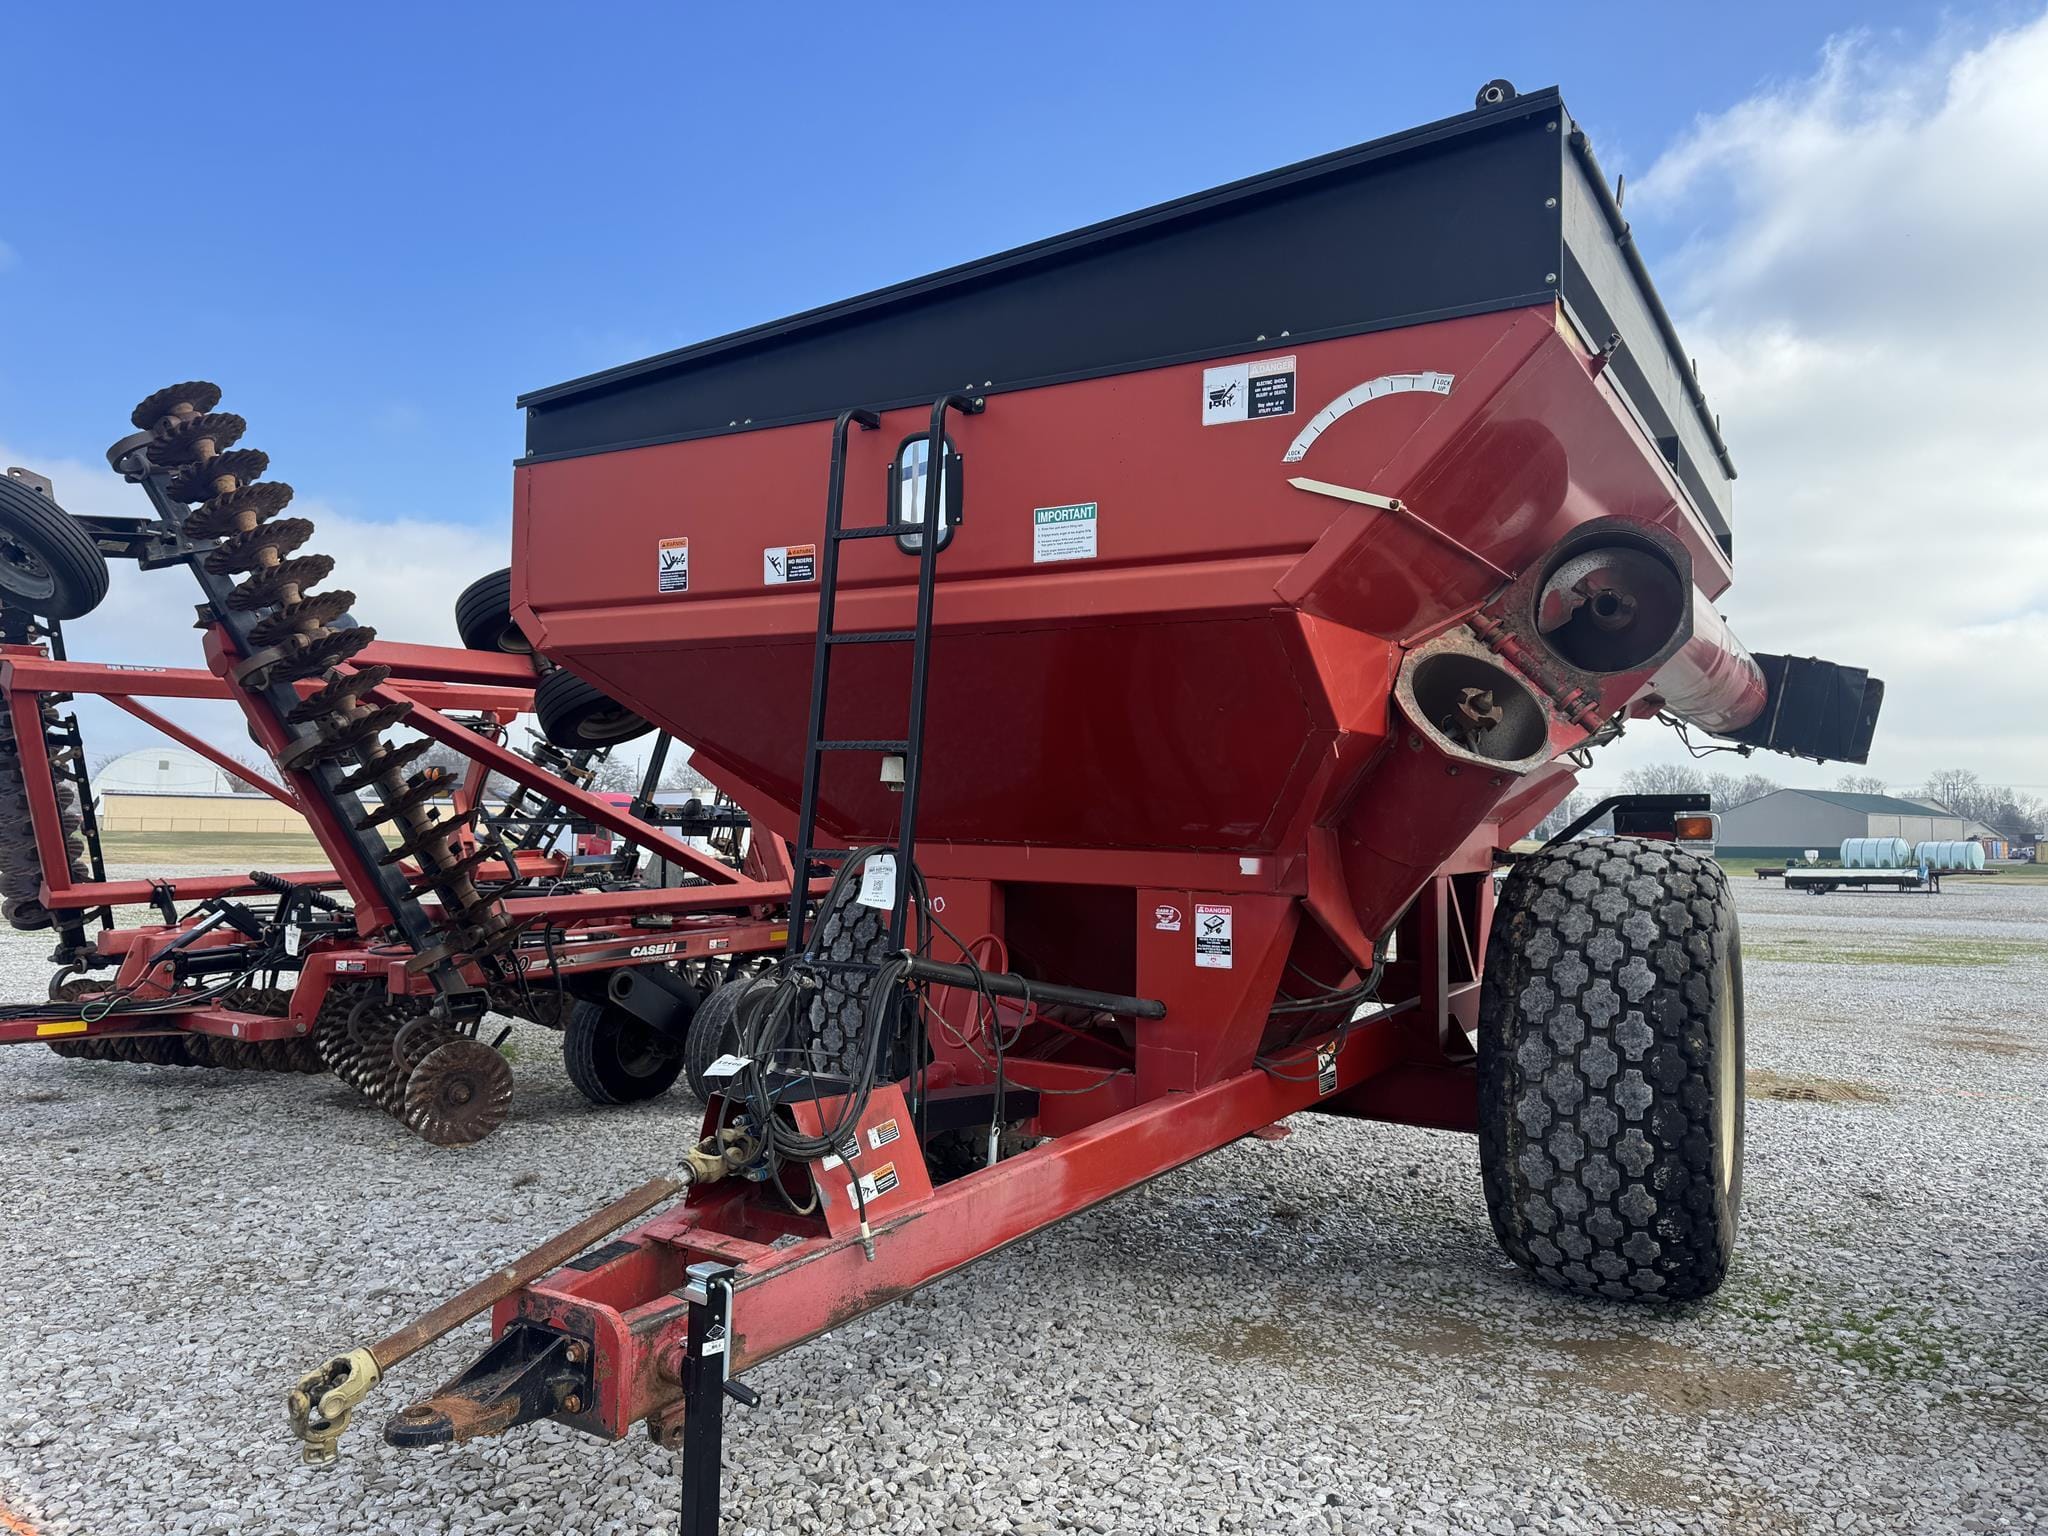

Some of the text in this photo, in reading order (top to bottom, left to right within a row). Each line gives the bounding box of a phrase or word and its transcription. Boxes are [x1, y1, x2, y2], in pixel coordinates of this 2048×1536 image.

[1260, 360, 1294, 371] DANGER
[1437, 378, 1450, 386] LOCK
[1037, 506, 1094, 523] IMPORTANT
[630, 944, 665, 957] CASE
